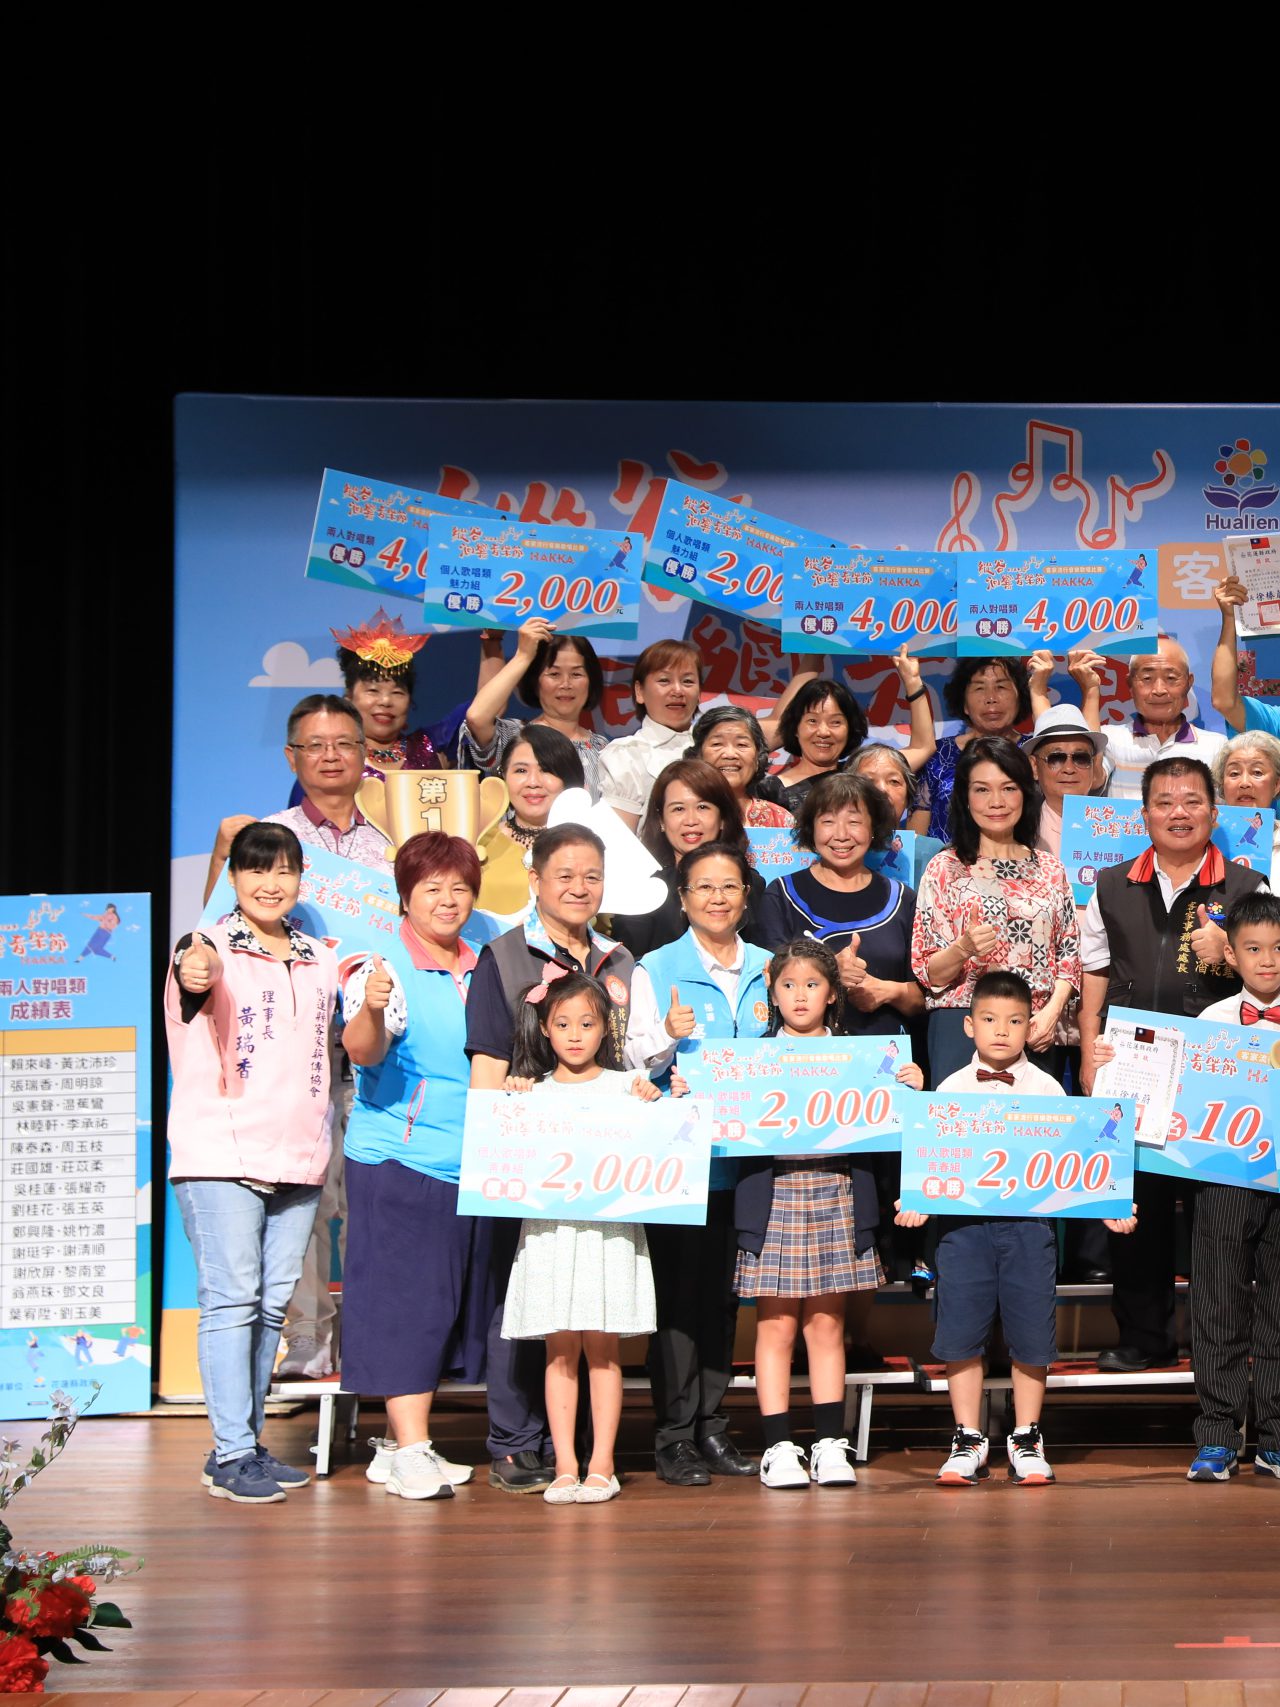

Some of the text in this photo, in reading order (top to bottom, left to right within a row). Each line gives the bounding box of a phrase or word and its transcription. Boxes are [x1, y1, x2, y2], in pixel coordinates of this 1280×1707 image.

[1206, 514, 1280, 530] Hualien
[327, 526, 376, 546] 兩人對唱類
[666, 529, 711, 552] 個人歌唱類
[331, 545, 365, 566] 優勝
[672, 544, 698, 561] 魅力組
[746, 537, 783, 557] HAKKA
[530, 552, 575, 564] HAKKA
[440, 565, 492, 578] 個人歌唱類
[664, 558, 696, 582] 優勝
[705, 551, 783, 604] 2,00
[450, 579, 480, 590] 魅力組
[879, 577, 922, 588] HAKKA
[1051, 577, 1095, 587] HAKKA
[447, 592, 482, 613] 優勝
[493, 570, 619, 615] 2,000
[794, 601, 844, 612] 兩人對唱類
[970, 604, 1018, 615] 兩人對唱類
[803, 614, 836, 634] 優勝
[849, 597, 958, 641] 4,000
[978, 618, 1011, 636] 優勝
[1023, 597, 1139, 641] 4,000
[418, 774, 448, 832] 第1
[745, 851, 793, 868] 響音樂節
[1073, 850, 1124, 862] 兩人對唱類
[299, 881, 362, 917] 響音樂節
[0, 978, 86, 996] 兩人對唱類
[11, 1001, 71, 1020] 成績表
[262, 990, 275, 1040] 理事長
[236, 1006, 256, 1079] 黃瑞香
[790, 1066, 839, 1078] HAKKA
[1182, 1052, 1238, 1076] 音樂節
[712, 1105, 740, 1116] 春組
[758, 1088, 892, 1139] 2,000
[928, 1103, 961, 1120] 縱谷
[1013, 1126, 1062, 1138] HAKKA
[1192, 1100, 1272, 1161] 10,
[917, 1146, 973, 1159] 個人歌唱類
[540, 1151, 685, 1203] 2,000
[928, 1161, 961, 1173] 青春組
[975, 1149, 1112, 1200] 2,000
[926, 1178, 962, 1198] 優勝
